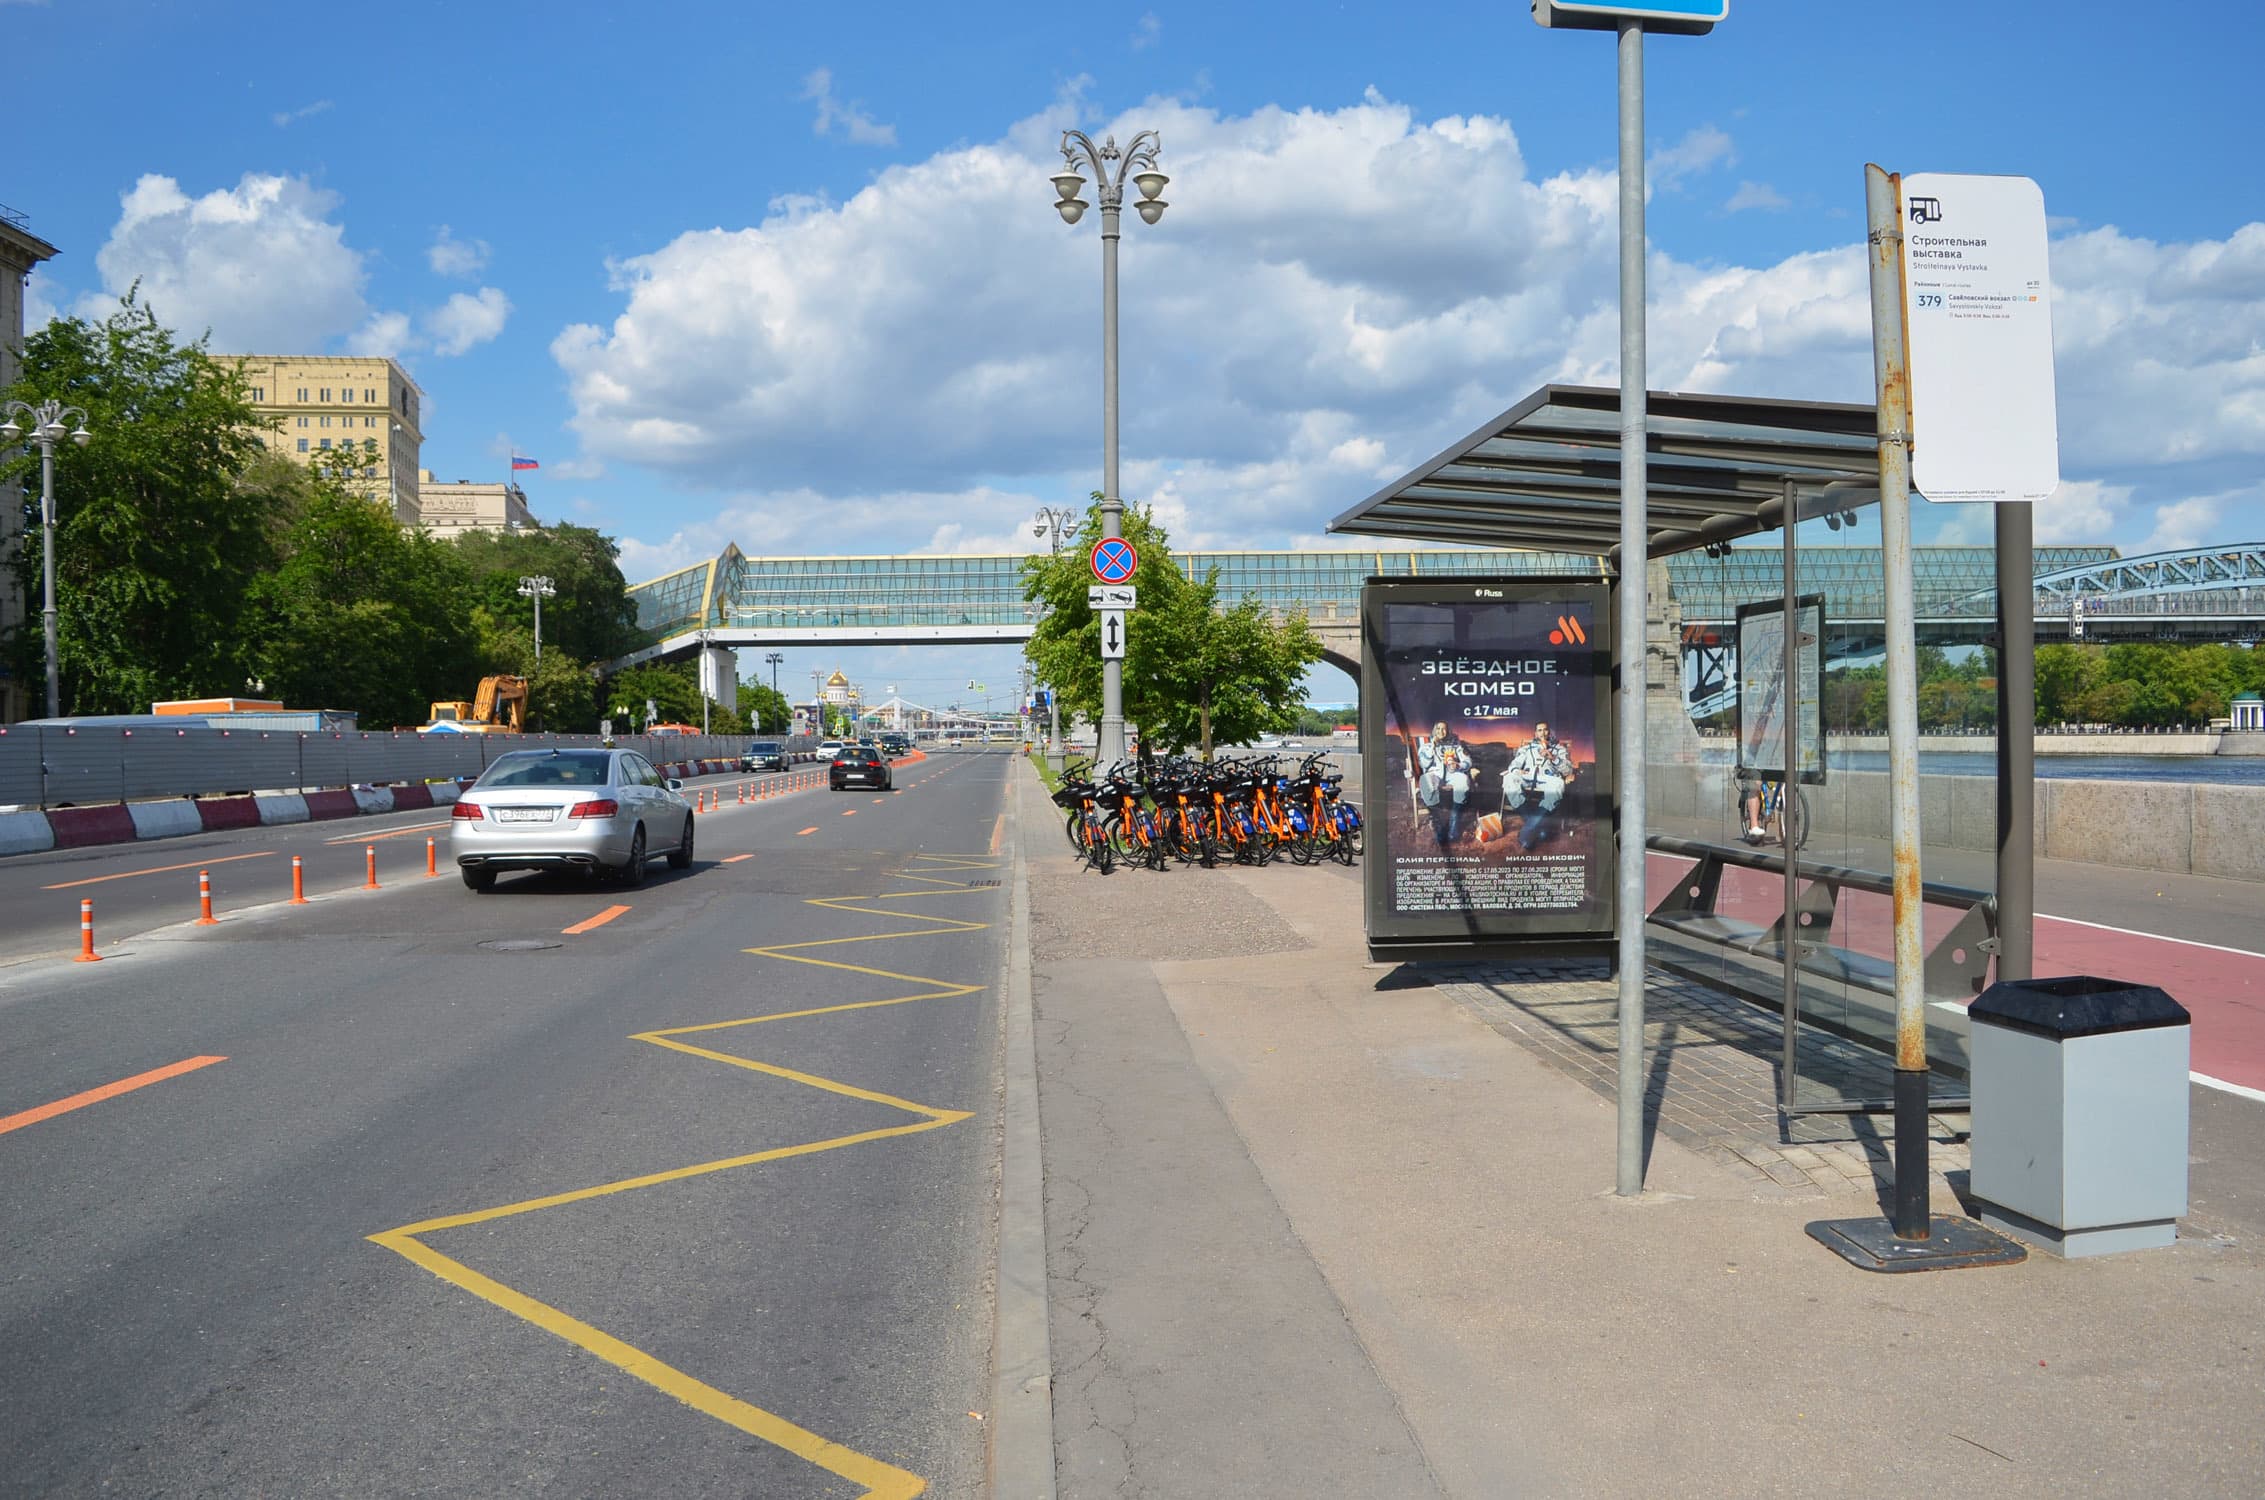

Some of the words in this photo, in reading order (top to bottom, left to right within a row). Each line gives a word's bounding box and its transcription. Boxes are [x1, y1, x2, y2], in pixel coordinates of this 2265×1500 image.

[1911, 235, 1987, 248] Строительная
[1912, 250, 1963, 259] выставка
[1957, 263, 1988, 272] Vystavka
[1918, 295, 1942, 307] 379
[1483, 589, 1504, 598] Russ
[1421, 656, 1558, 677] ЗВЁЗДНОЕ
[1444, 680, 1536, 697] КОМБО
[1463, 707, 1472, 717] с
[1473, 705, 1490, 717] 17
[1493, 706, 1519, 717] мая
